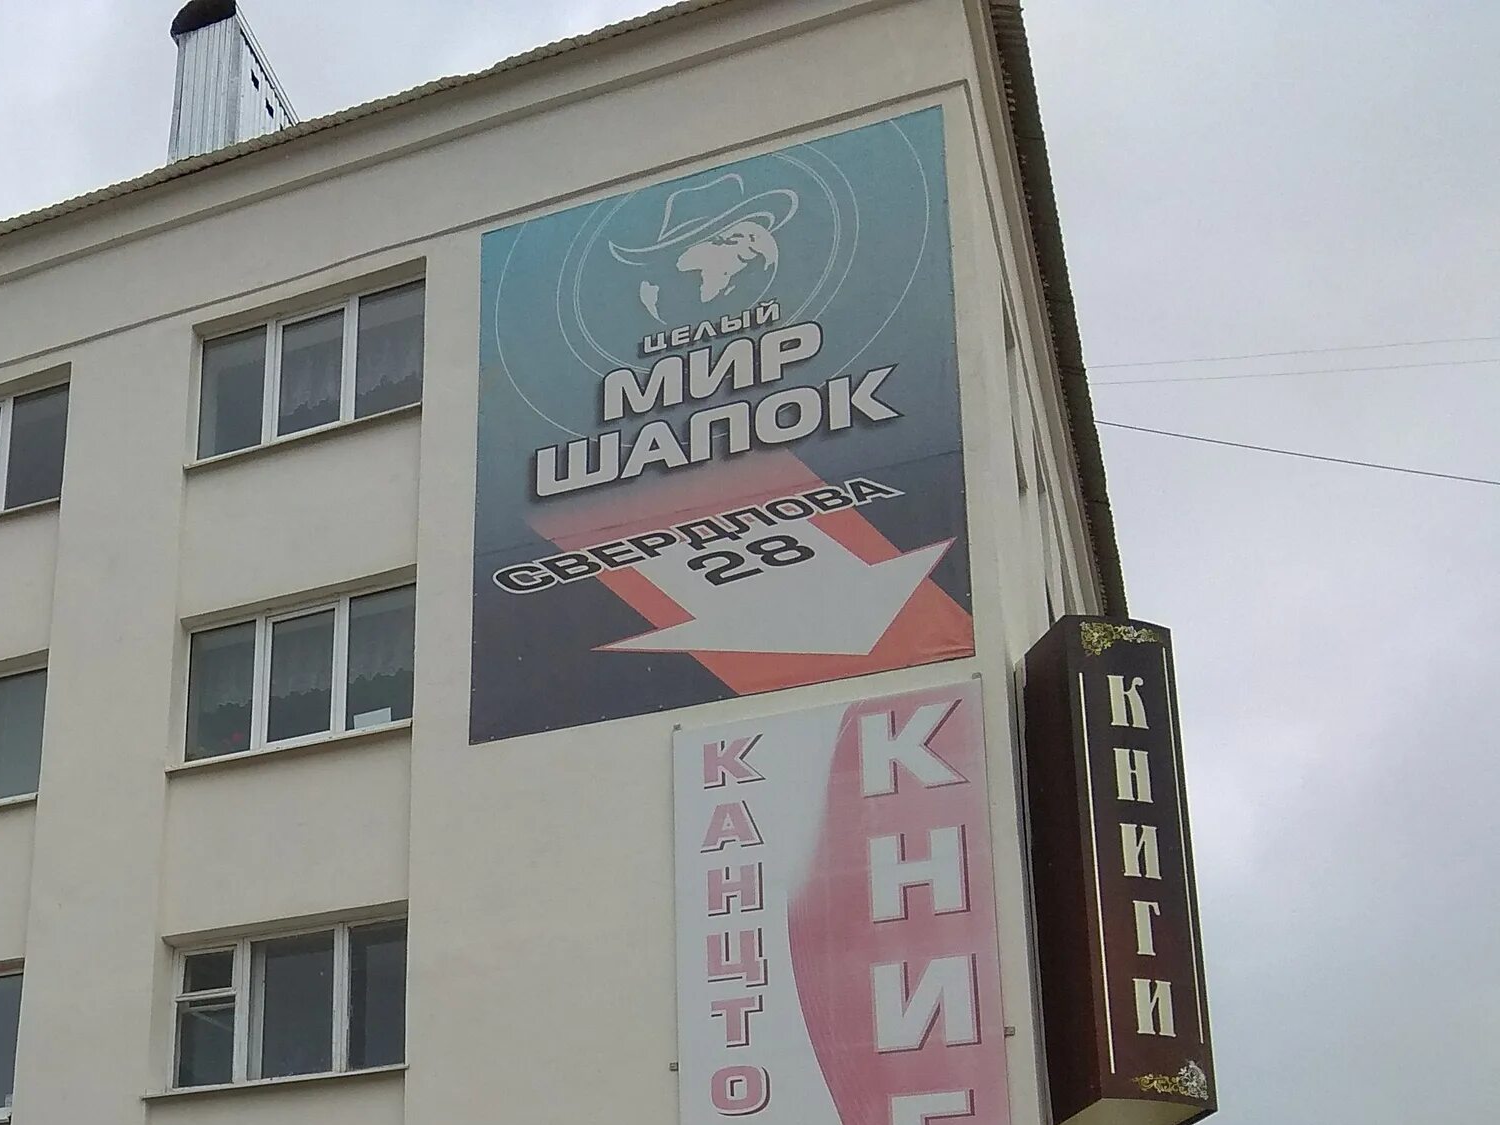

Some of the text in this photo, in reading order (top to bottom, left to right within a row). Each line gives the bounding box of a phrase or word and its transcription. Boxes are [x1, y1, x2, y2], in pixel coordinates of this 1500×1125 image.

[603, 322, 824, 421] МИР
[644, 299, 781, 354] ЦЕЛЫЙ
[535, 363, 904, 498] ШАПОК
[492, 477, 905, 595] СВЕРДЛОВА
[685, 532, 816, 588] 28
[1107, 675, 1176, 1037] КНИГИ
